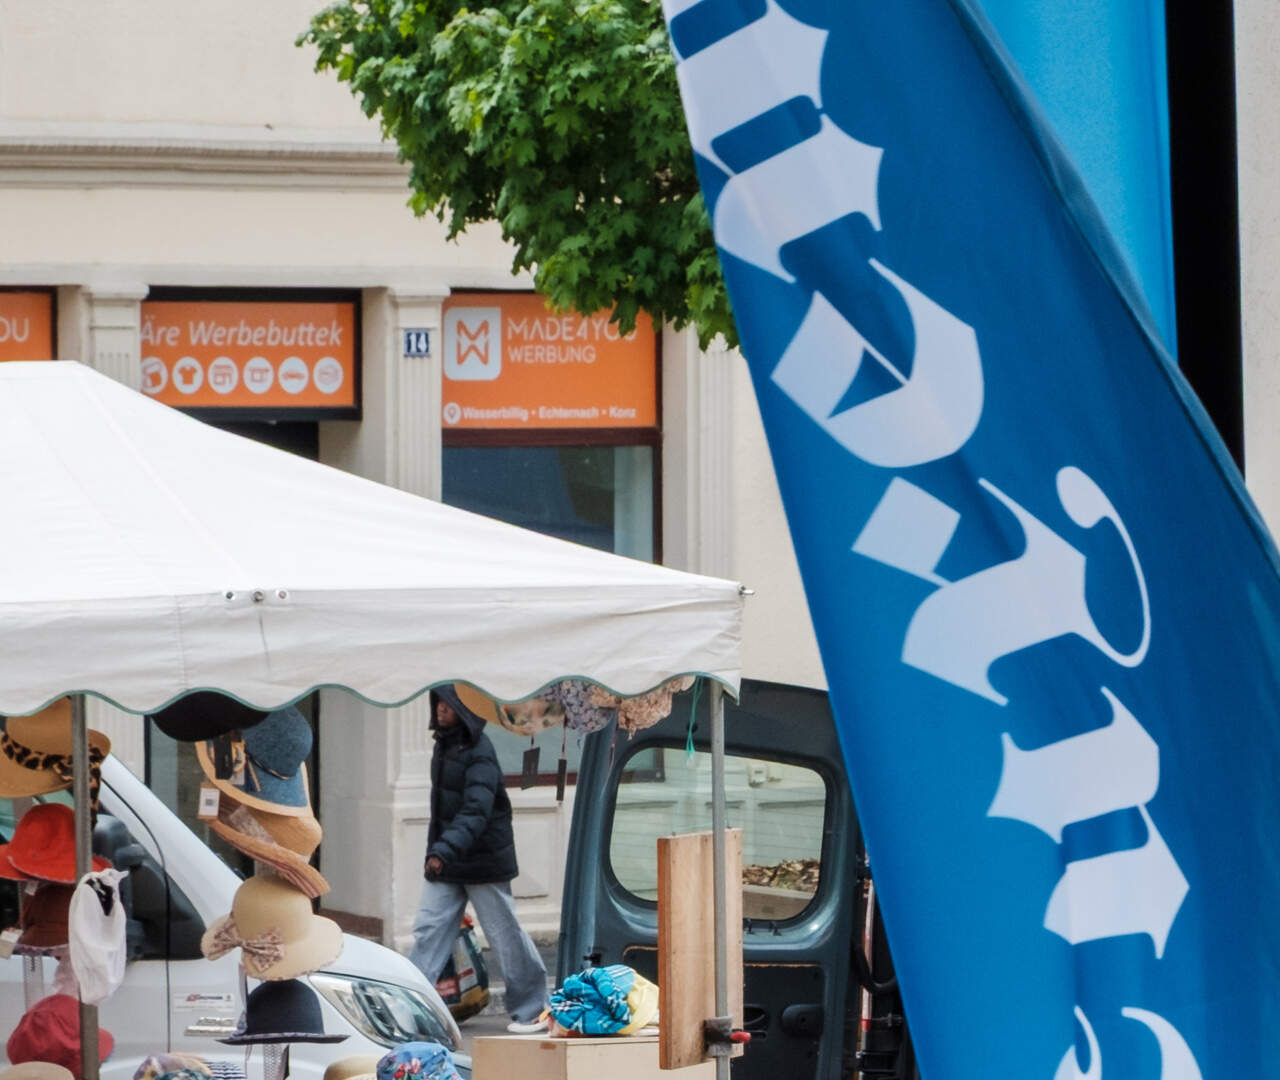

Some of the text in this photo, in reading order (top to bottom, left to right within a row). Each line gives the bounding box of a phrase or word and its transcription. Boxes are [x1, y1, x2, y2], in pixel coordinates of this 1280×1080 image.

[141, 314, 344, 346] Äre Werbebuttek
[408, 331, 428, 353] 14
[507, 345, 597, 364] WERBUNG
[462, 406, 637, 422] Wasserbillig Echternach Konz
